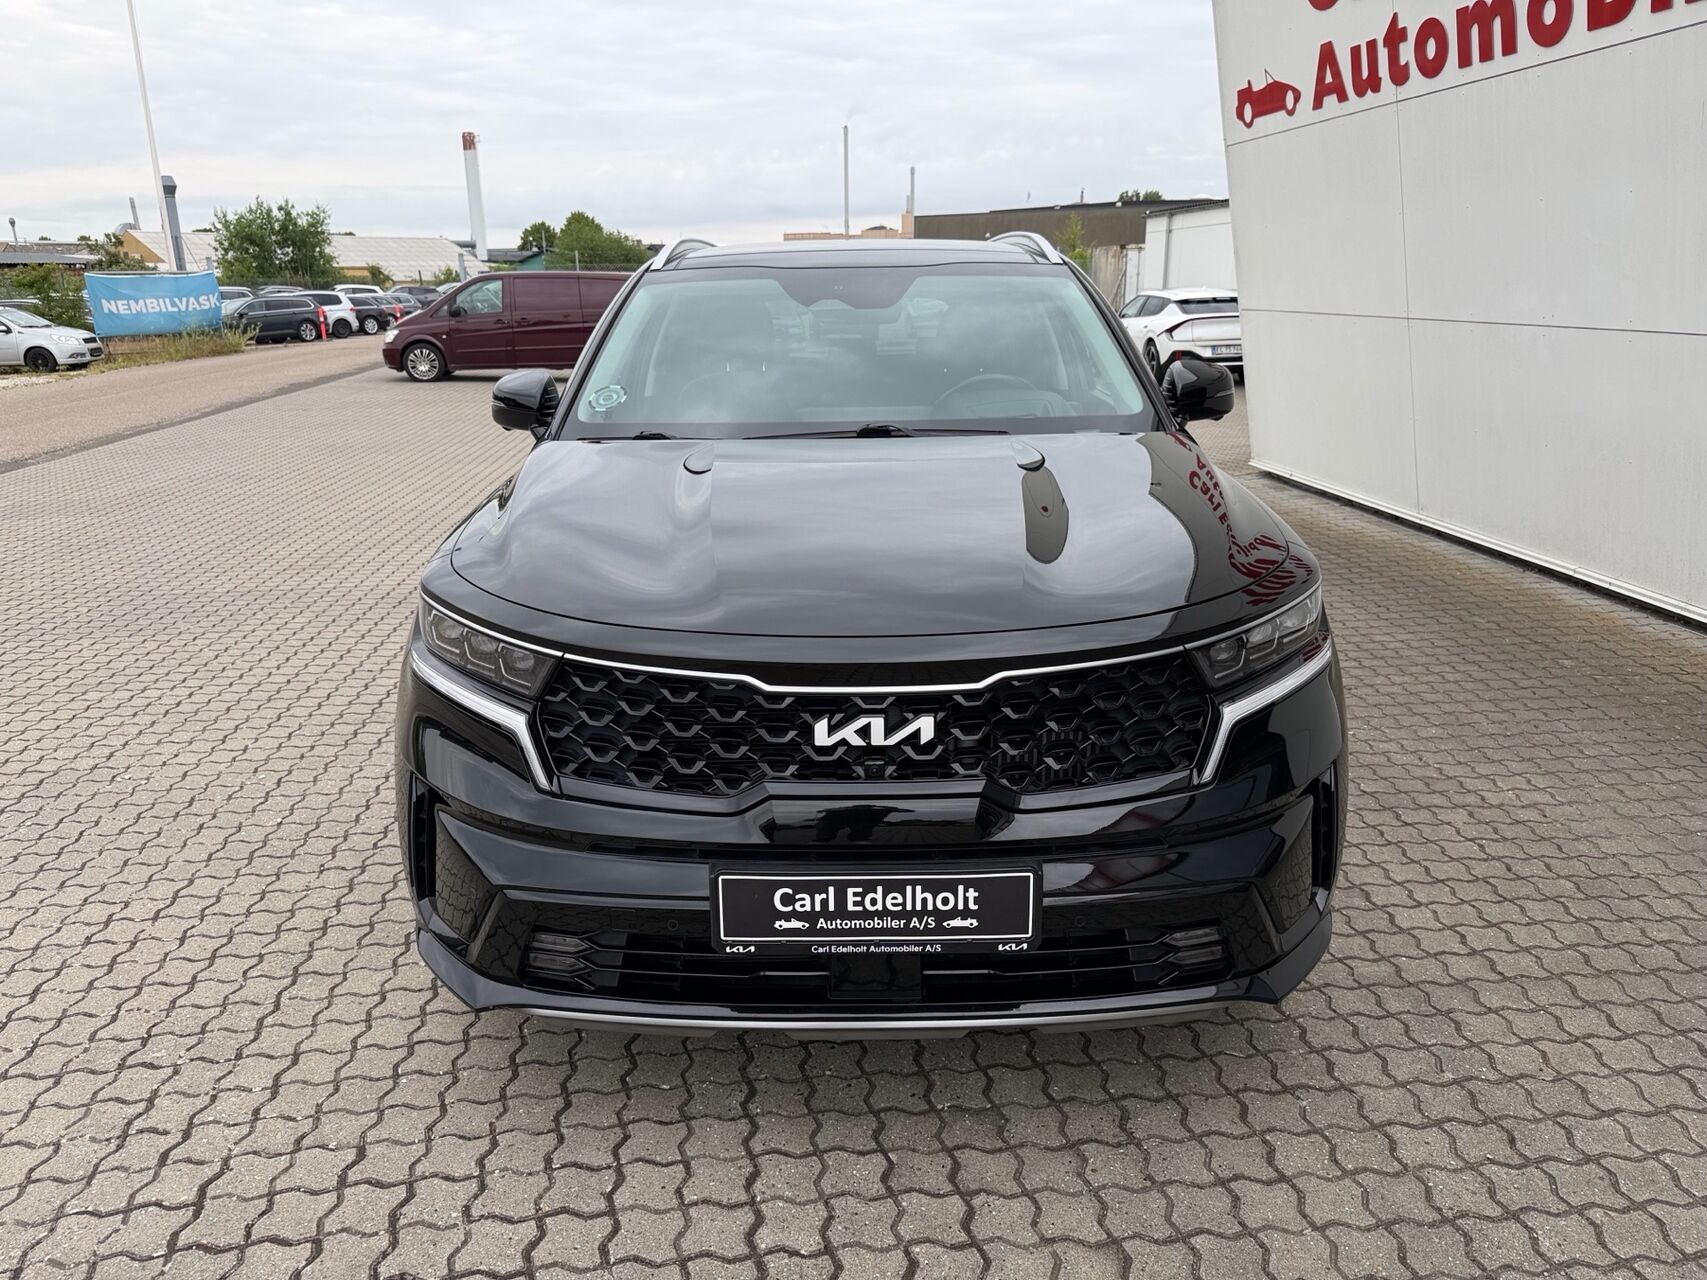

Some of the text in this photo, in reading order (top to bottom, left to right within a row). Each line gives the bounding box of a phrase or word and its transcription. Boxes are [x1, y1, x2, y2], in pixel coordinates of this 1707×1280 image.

[101, 293, 220, 314] NEMBILVASK
[813, 715, 936, 747] KIA
[773, 884, 979, 912] Carl Edelholt
[816, 915, 936, 931] Automobiler A/S
[811, 944, 942, 953] Carl Edelholt Automobiler A/S
